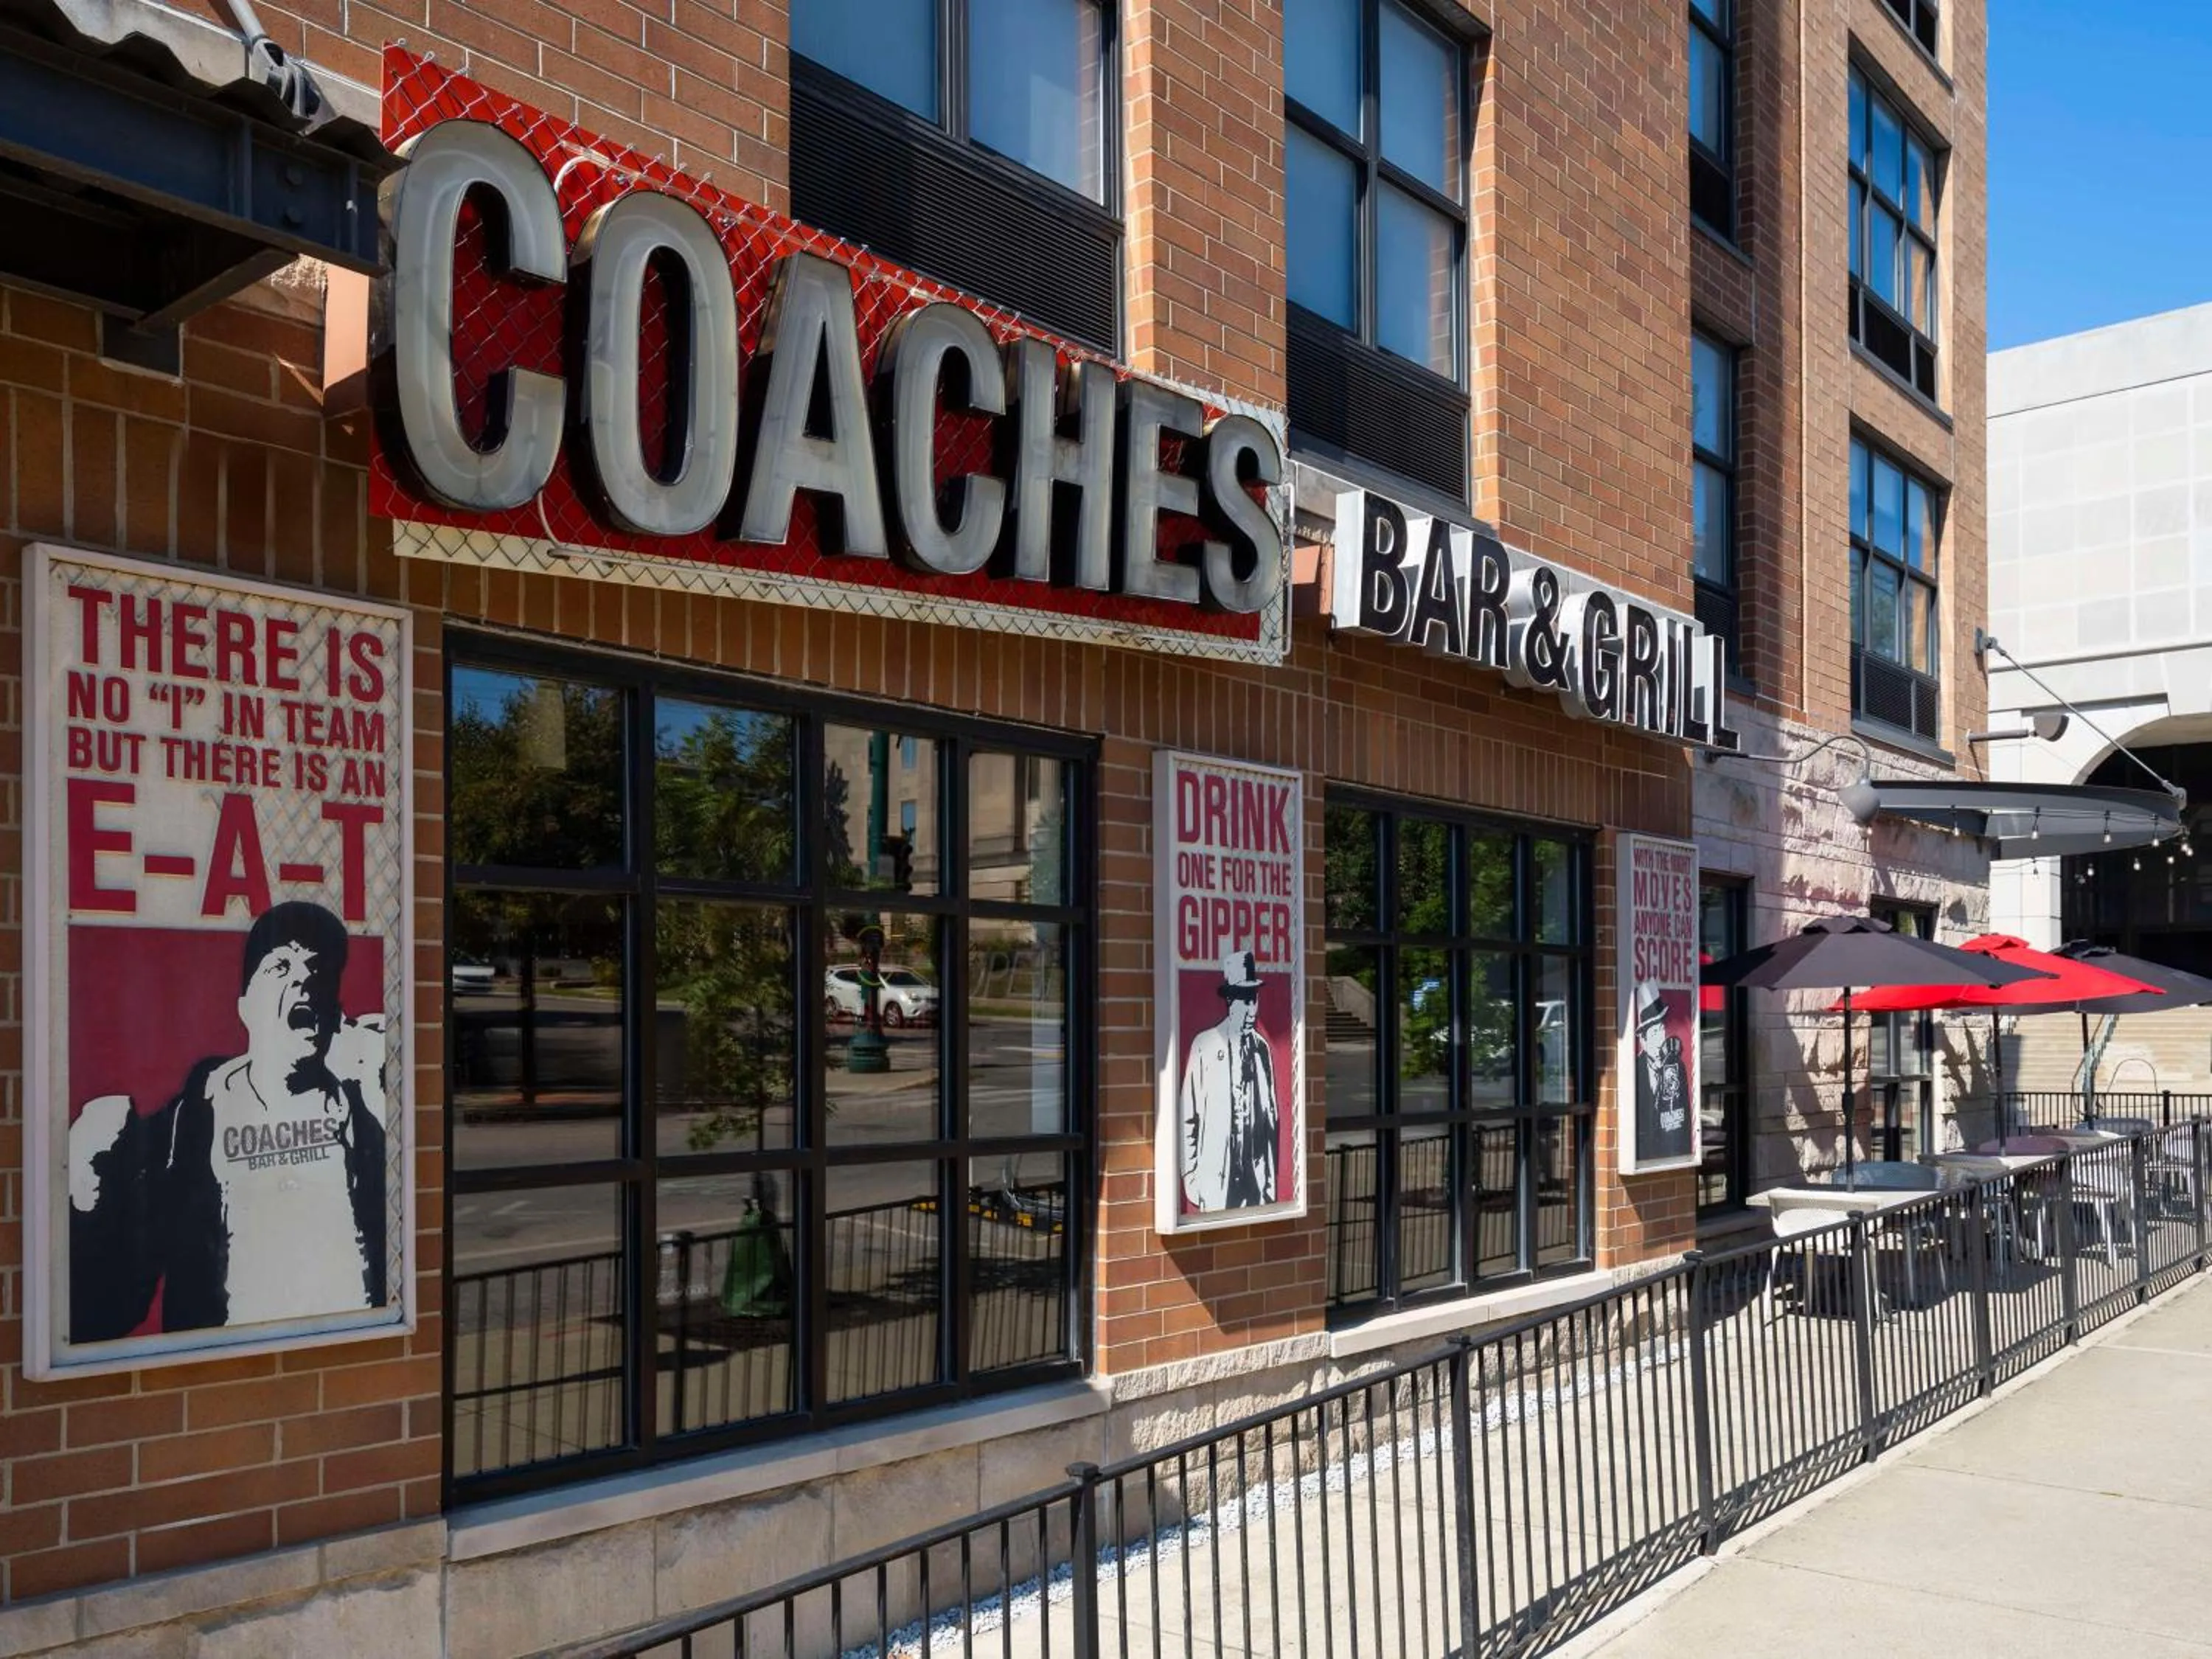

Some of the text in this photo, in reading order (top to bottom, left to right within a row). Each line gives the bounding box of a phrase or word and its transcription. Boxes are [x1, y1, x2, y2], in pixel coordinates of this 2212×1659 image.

[391, 116, 1284, 613] COACHES
[68, 585, 385, 704] THERE IS
[1358, 488, 1741, 751] BAR & GRILL
[67, 670, 130, 724] NO
[223, 692, 265, 740] IN
[280, 700, 386, 754] TEAM
[67, 726, 386, 798] BUT THERE IS AN
[1177, 769, 1290, 855] DRINK
[66, 777, 385, 922] E-A-T
[1178, 851, 1292, 897] ONE FOR THE
[1633, 849, 1654, 869] WITH
[1655, 851, 1669, 871] THE
[1633, 871, 1692, 912] MOVES
[1634, 910, 1692, 939] ANYONE CAN
[1178, 894, 1291, 963] GIPPER
[1634, 937, 1692, 984] SCORE
[223, 1117, 338, 1158] COACHES
[248, 1147, 330, 1171] BAR & GRILL
